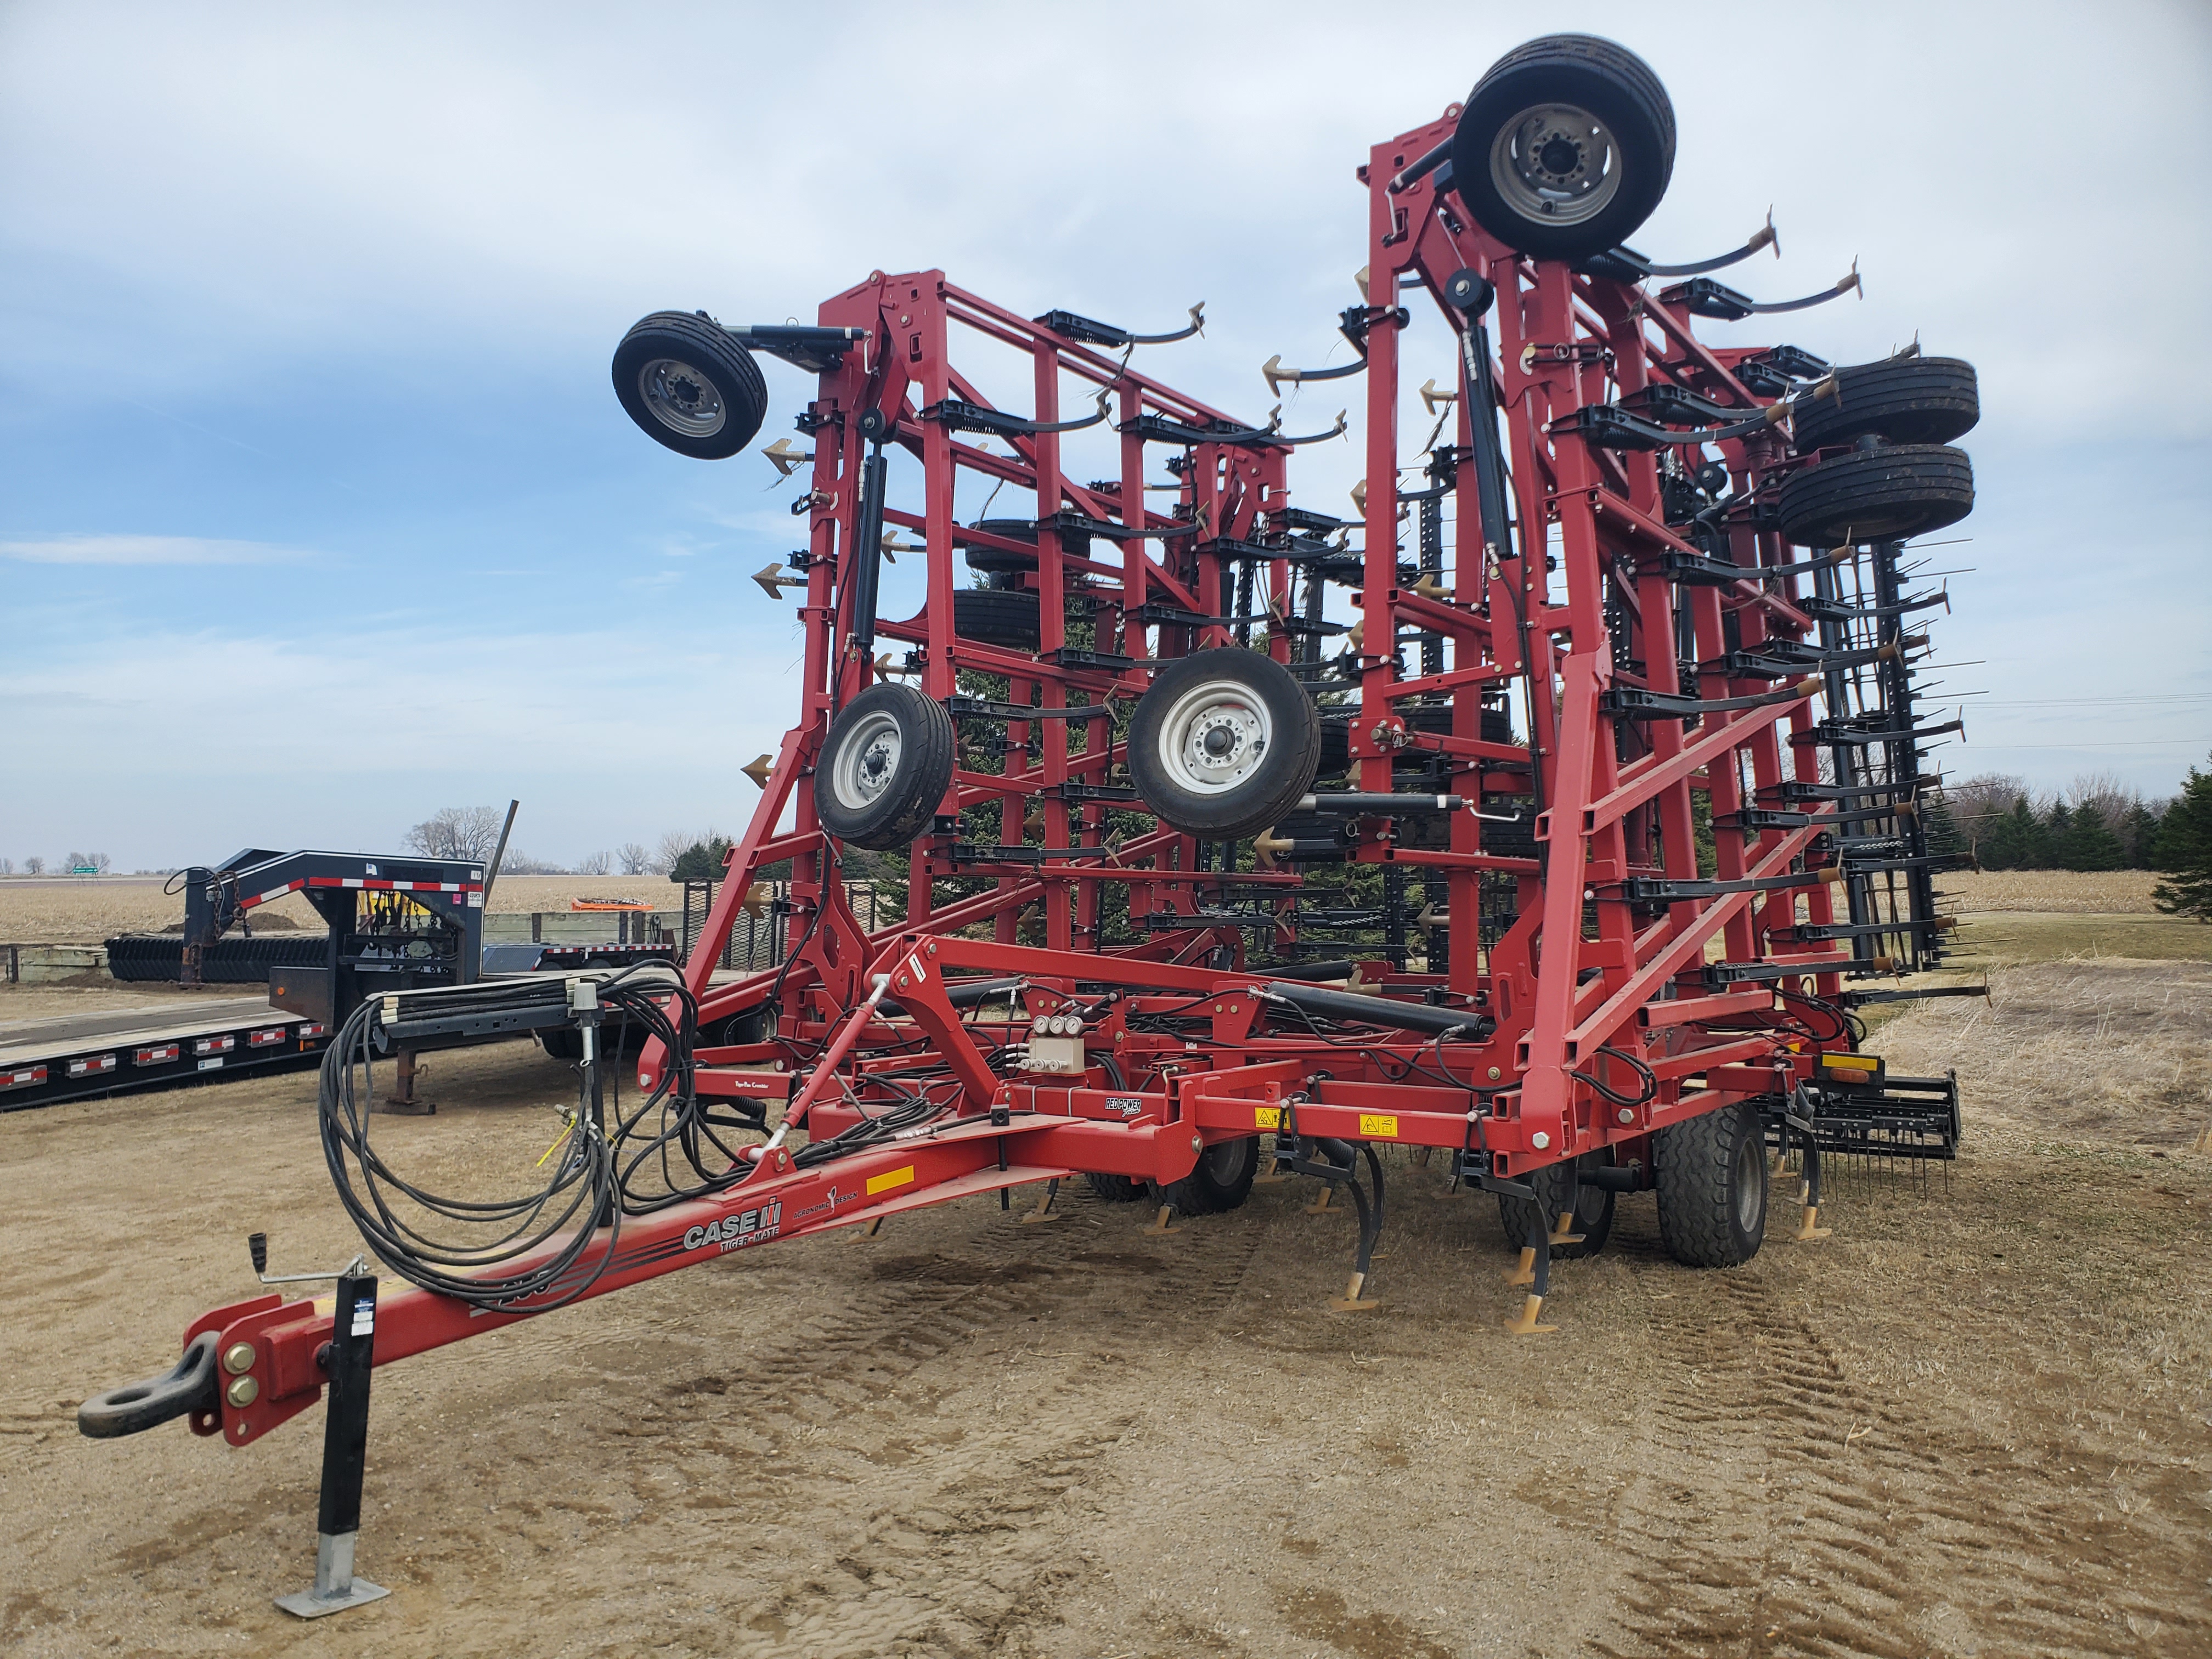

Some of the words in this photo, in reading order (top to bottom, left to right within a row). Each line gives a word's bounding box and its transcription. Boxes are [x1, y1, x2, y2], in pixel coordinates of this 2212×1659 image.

[1105, 1098, 1118, 1109] RED
[1119, 1099, 1141, 1110] POWER
[793, 1201, 830, 1219] AGRONOMIC
[835, 1191, 858, 1205] DESIGN
[684, 1209, 758, 1250] CASE
